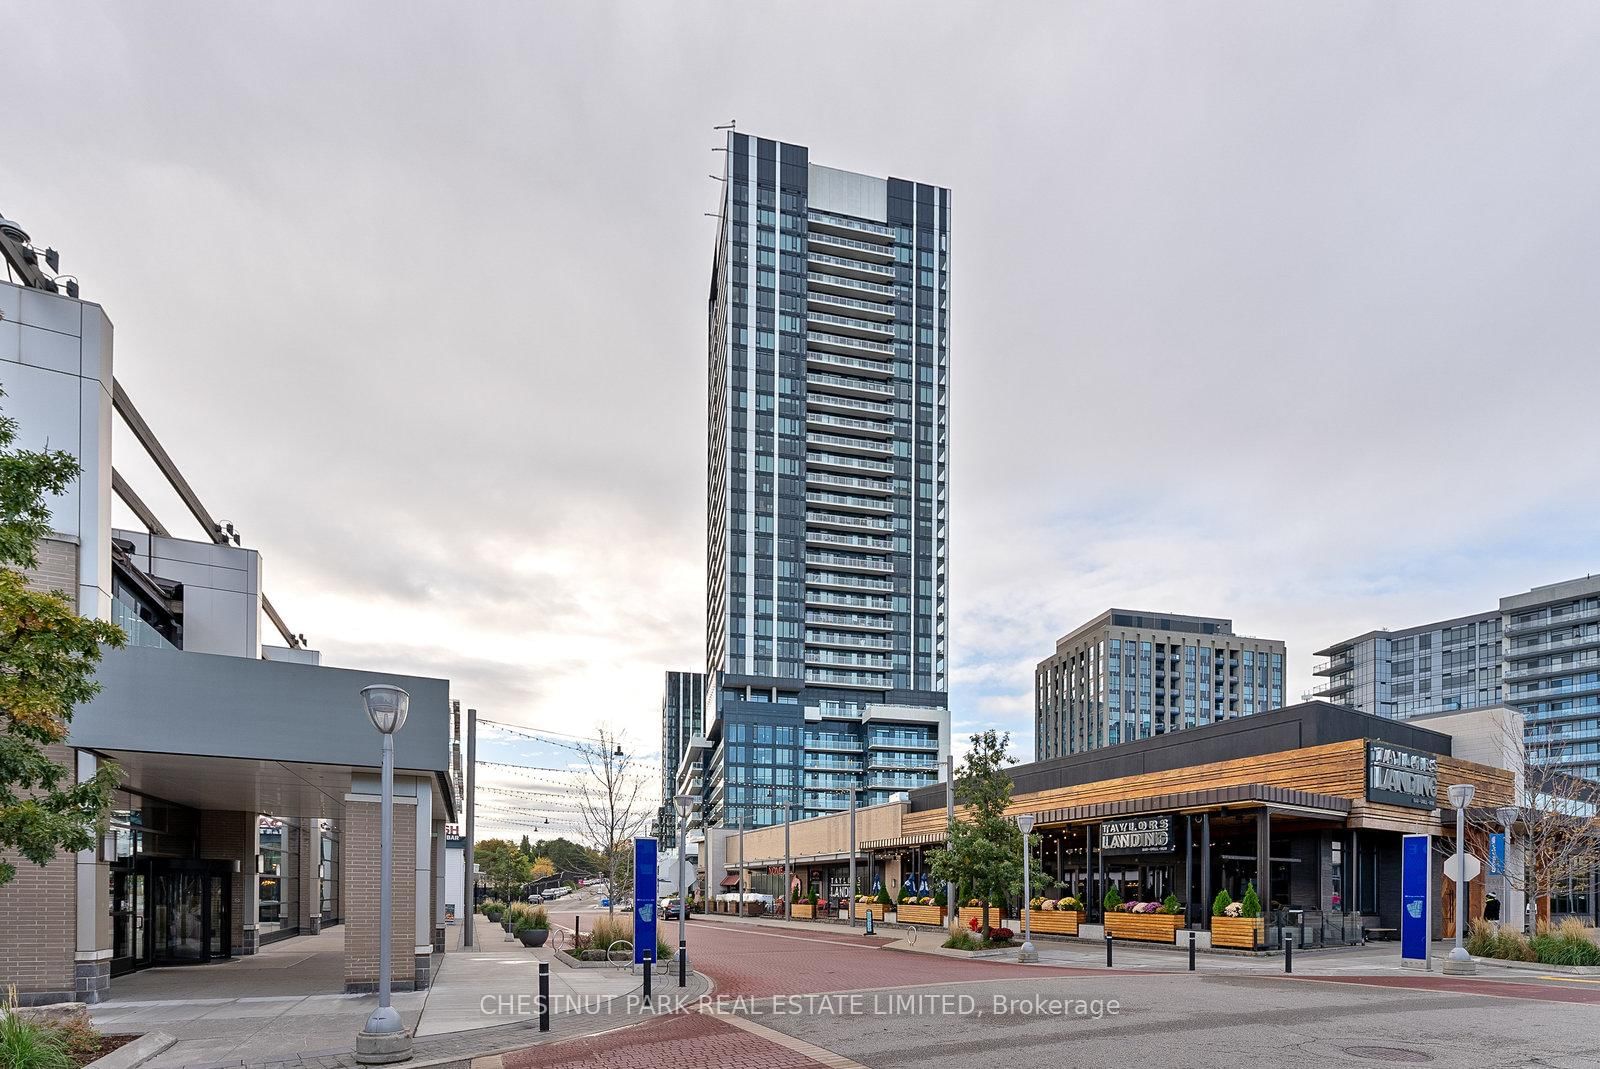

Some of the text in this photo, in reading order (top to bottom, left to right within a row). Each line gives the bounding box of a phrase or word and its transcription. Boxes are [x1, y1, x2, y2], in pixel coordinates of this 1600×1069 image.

[1370, 747, 1437, 772] TAYLORS
[1370, 766, 1437, 798] LANDING
[1102, 819, 1169, 833] TAYLORS
[1102, 831, 1169, 849] LANDING
